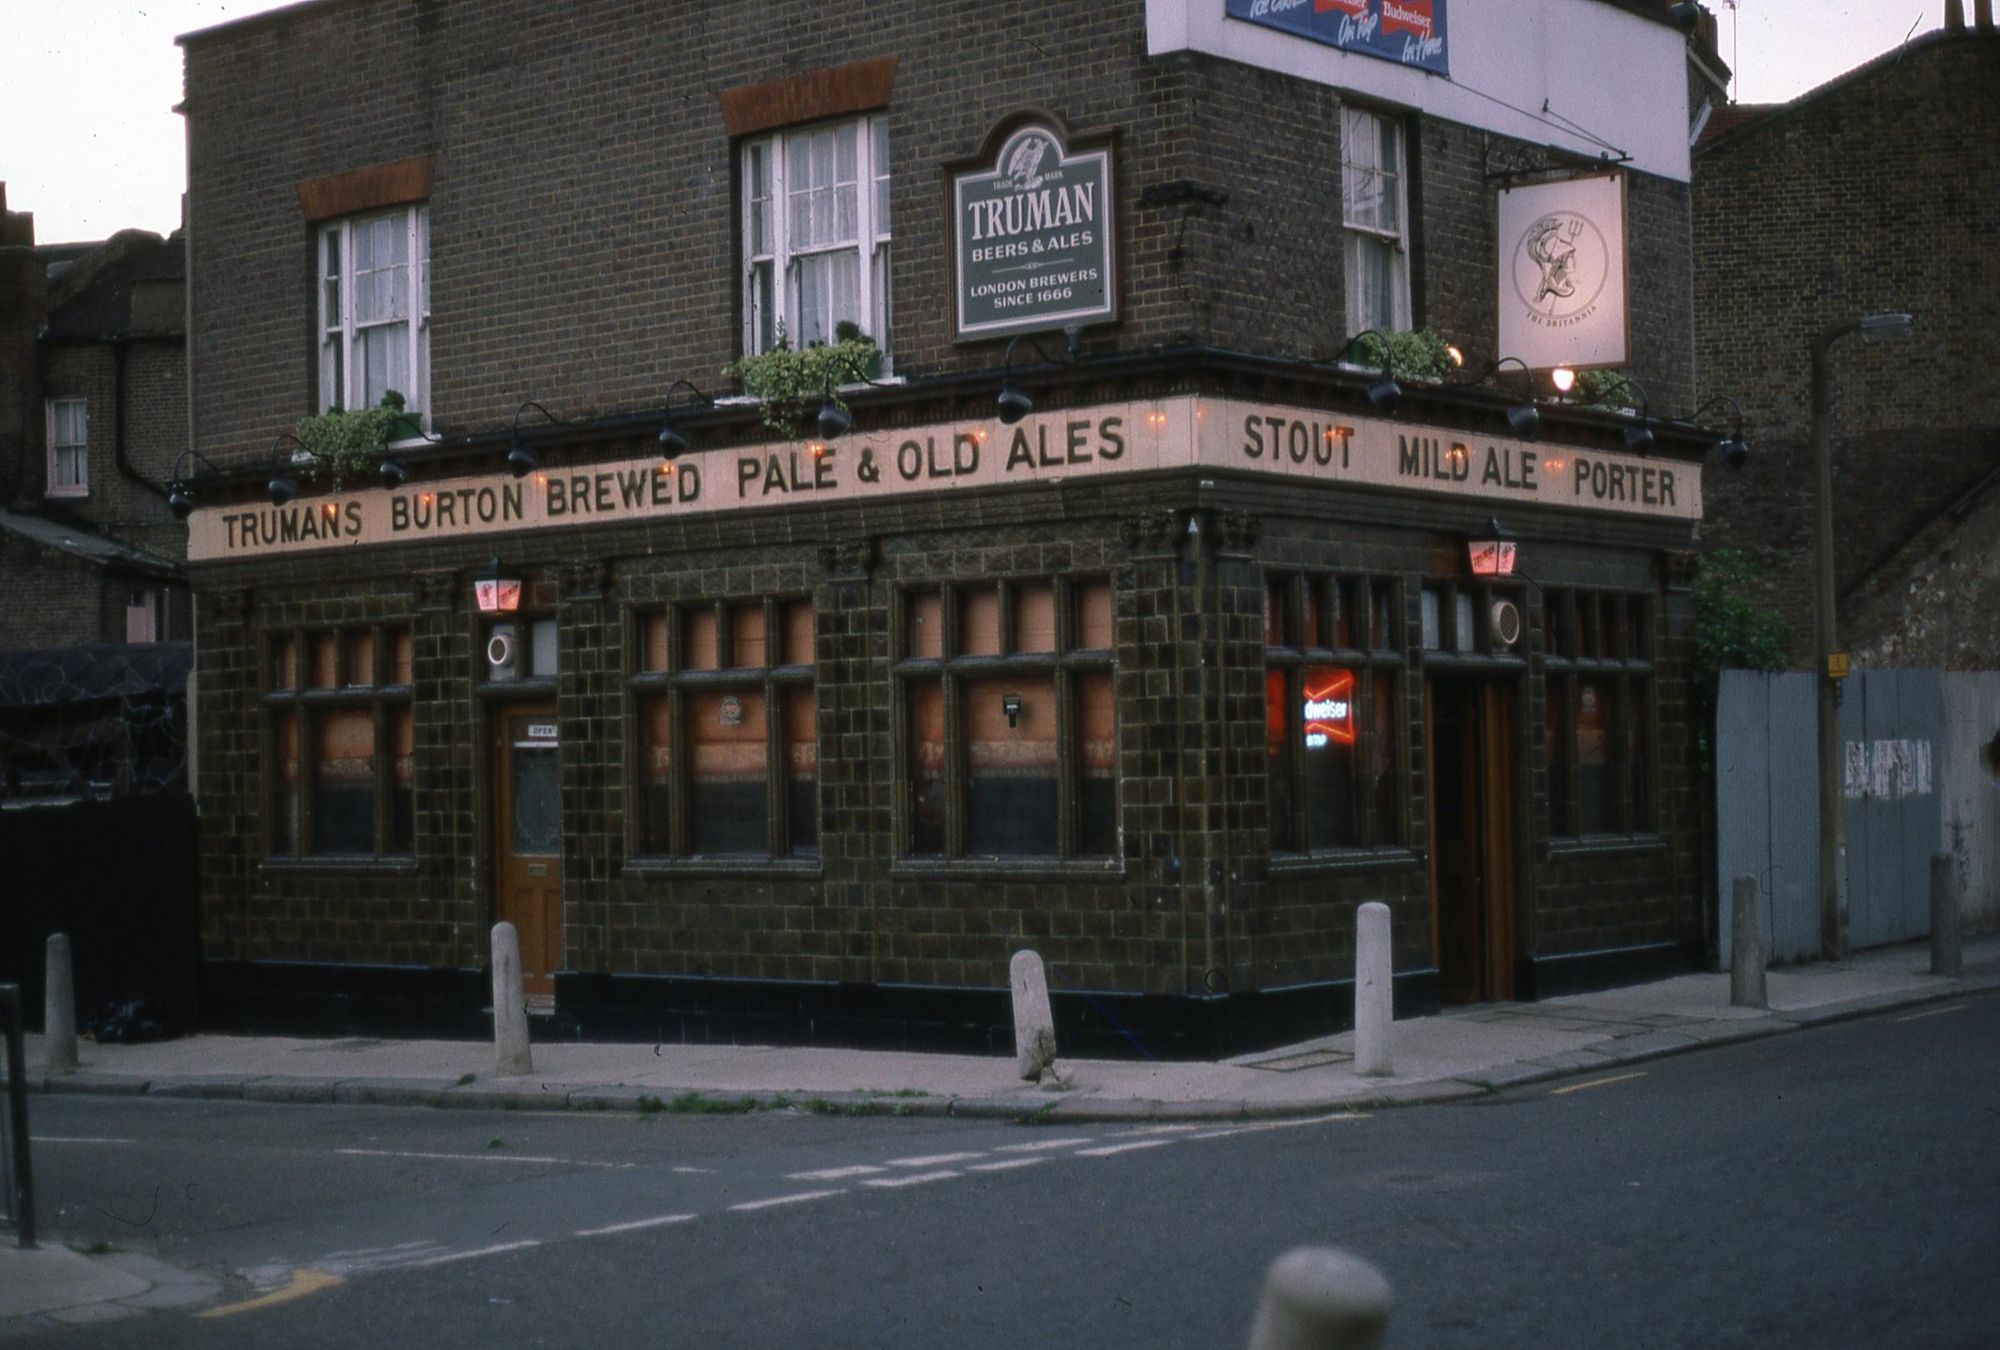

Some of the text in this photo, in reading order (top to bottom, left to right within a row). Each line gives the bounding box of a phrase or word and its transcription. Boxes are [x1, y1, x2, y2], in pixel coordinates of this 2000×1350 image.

[1383, 1, 1432, 28] Budweiser
[968, 182, 1095, 241] TRUMAN
[972, 231, 1093, 263] BEERS & ALES
[970, 268, 1098, 297] LONDON BREWERS
[994, 287, 1072, 309] SINCE 1666
[1243, 414, 1675, 506] STOUT MILD ALE PORTER
[222, 416, 1125, 548] TRUMANS BURTON BREWED PALE & OLD ALES
[1304, 699, 1347, 719] dweiser
[533, 726, 553, 735] OPEN
